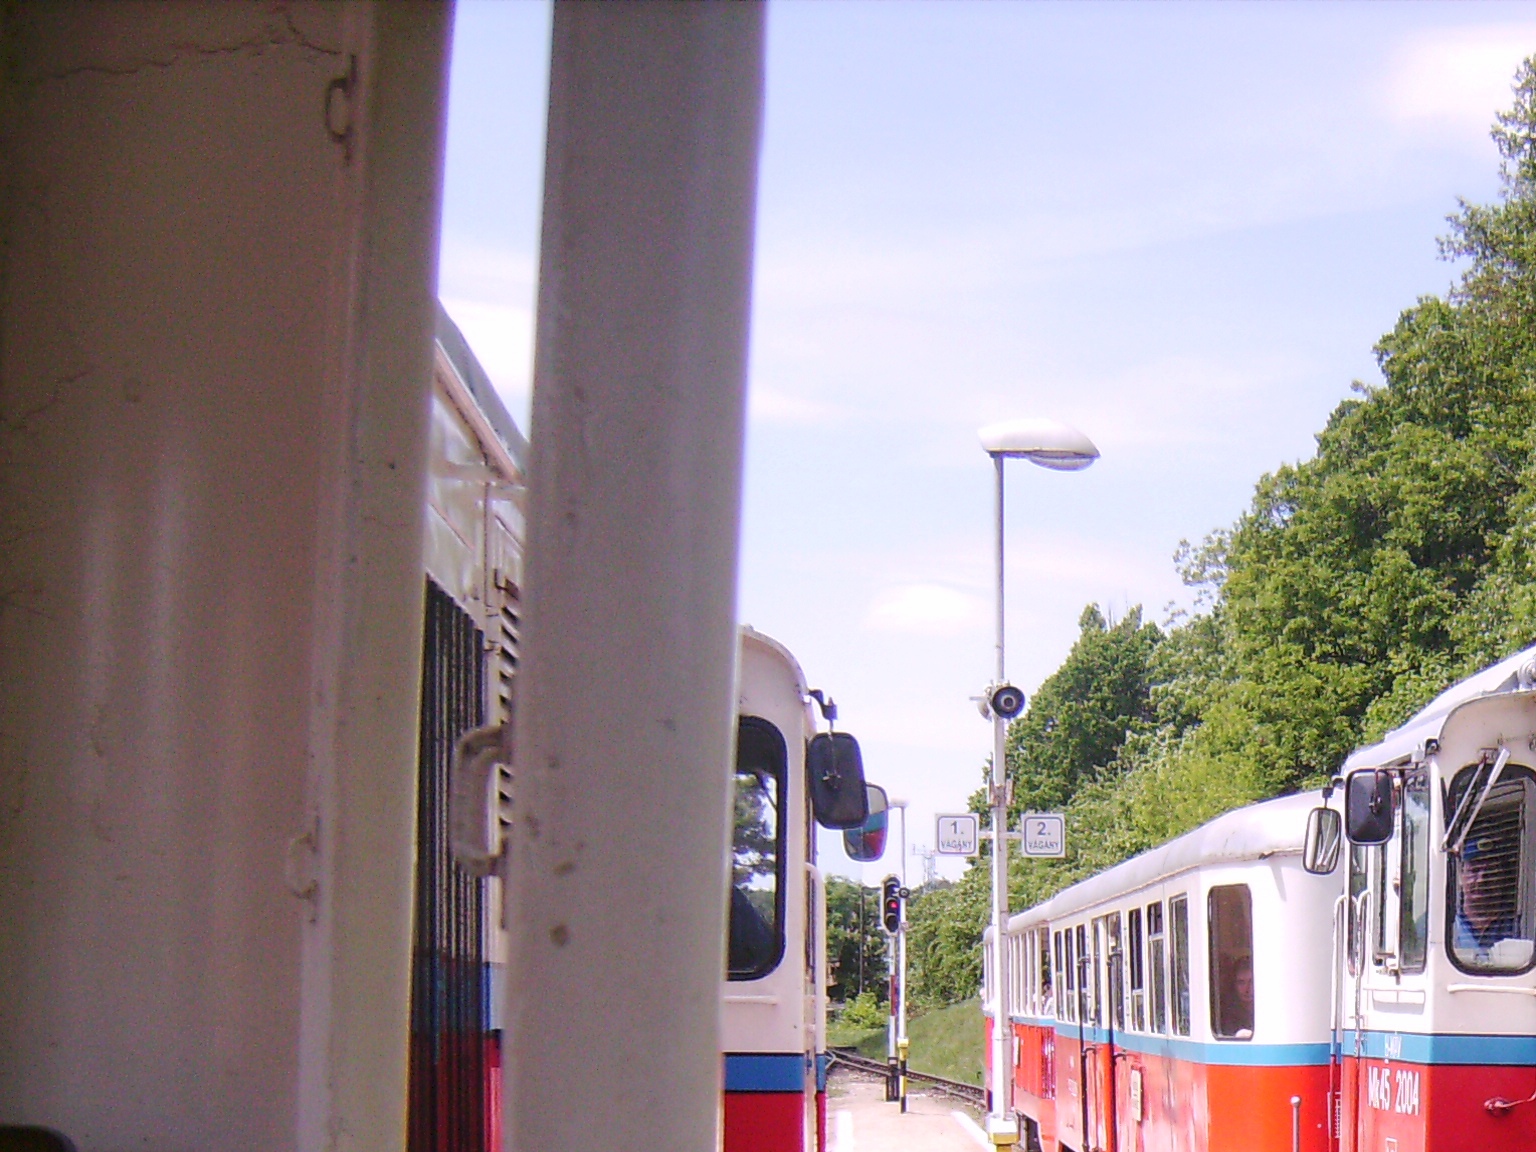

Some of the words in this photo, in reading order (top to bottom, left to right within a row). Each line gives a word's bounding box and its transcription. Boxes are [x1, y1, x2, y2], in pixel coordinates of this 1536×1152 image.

[950, 821, 965, 834] 1.
[1037, 821, 1051, 836] 2.
[1395, 1069, 1419, 1116] 2004
